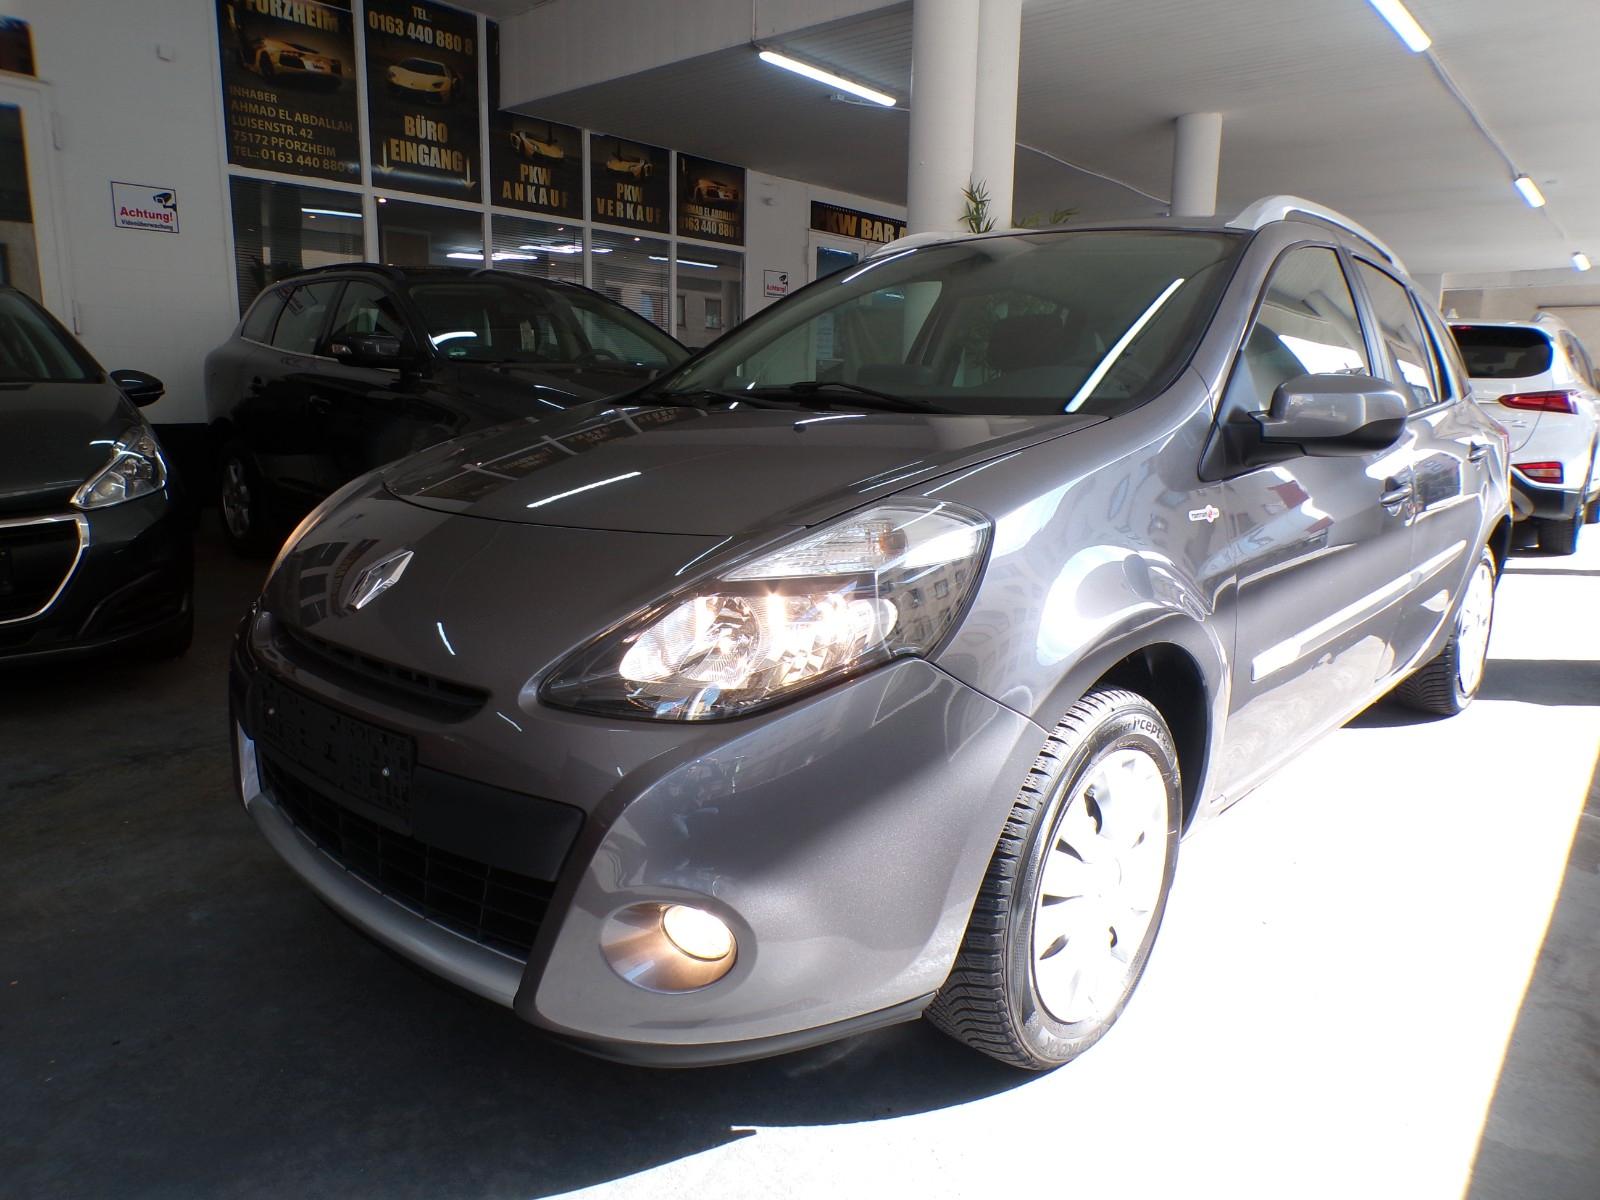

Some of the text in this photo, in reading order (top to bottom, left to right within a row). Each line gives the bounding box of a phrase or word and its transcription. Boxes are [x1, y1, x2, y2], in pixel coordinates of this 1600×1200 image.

[368, 10, 404, 36] 0163
[407, 22, 433, 44] 440
[436, 30, 461, 52] 880
[231, 101, 353, 133] AHMAD EL ABDALLAH
[232, 115, 313, 139] LUISENSTR. 42
[404, 114, 448, 143] BÜRO
[233, 130, 336, 157] 75172 PFORZHEIM
[390, 137, 465, 171] EINGANG
[261, 149, 294, 164] 0163
[296, 155, 320, 168] 440
[322, 159, 345, 172] 880
[519, 163, 551, 186] PKW
[502, 180, 569, 208] ANKAUF
[616, 182, 643, 203] PKW
[120, 206, 173, 223] Achtung!
[597, 197, 662, 225] VERKAUF
[861, 217, 895, 243] BAR
